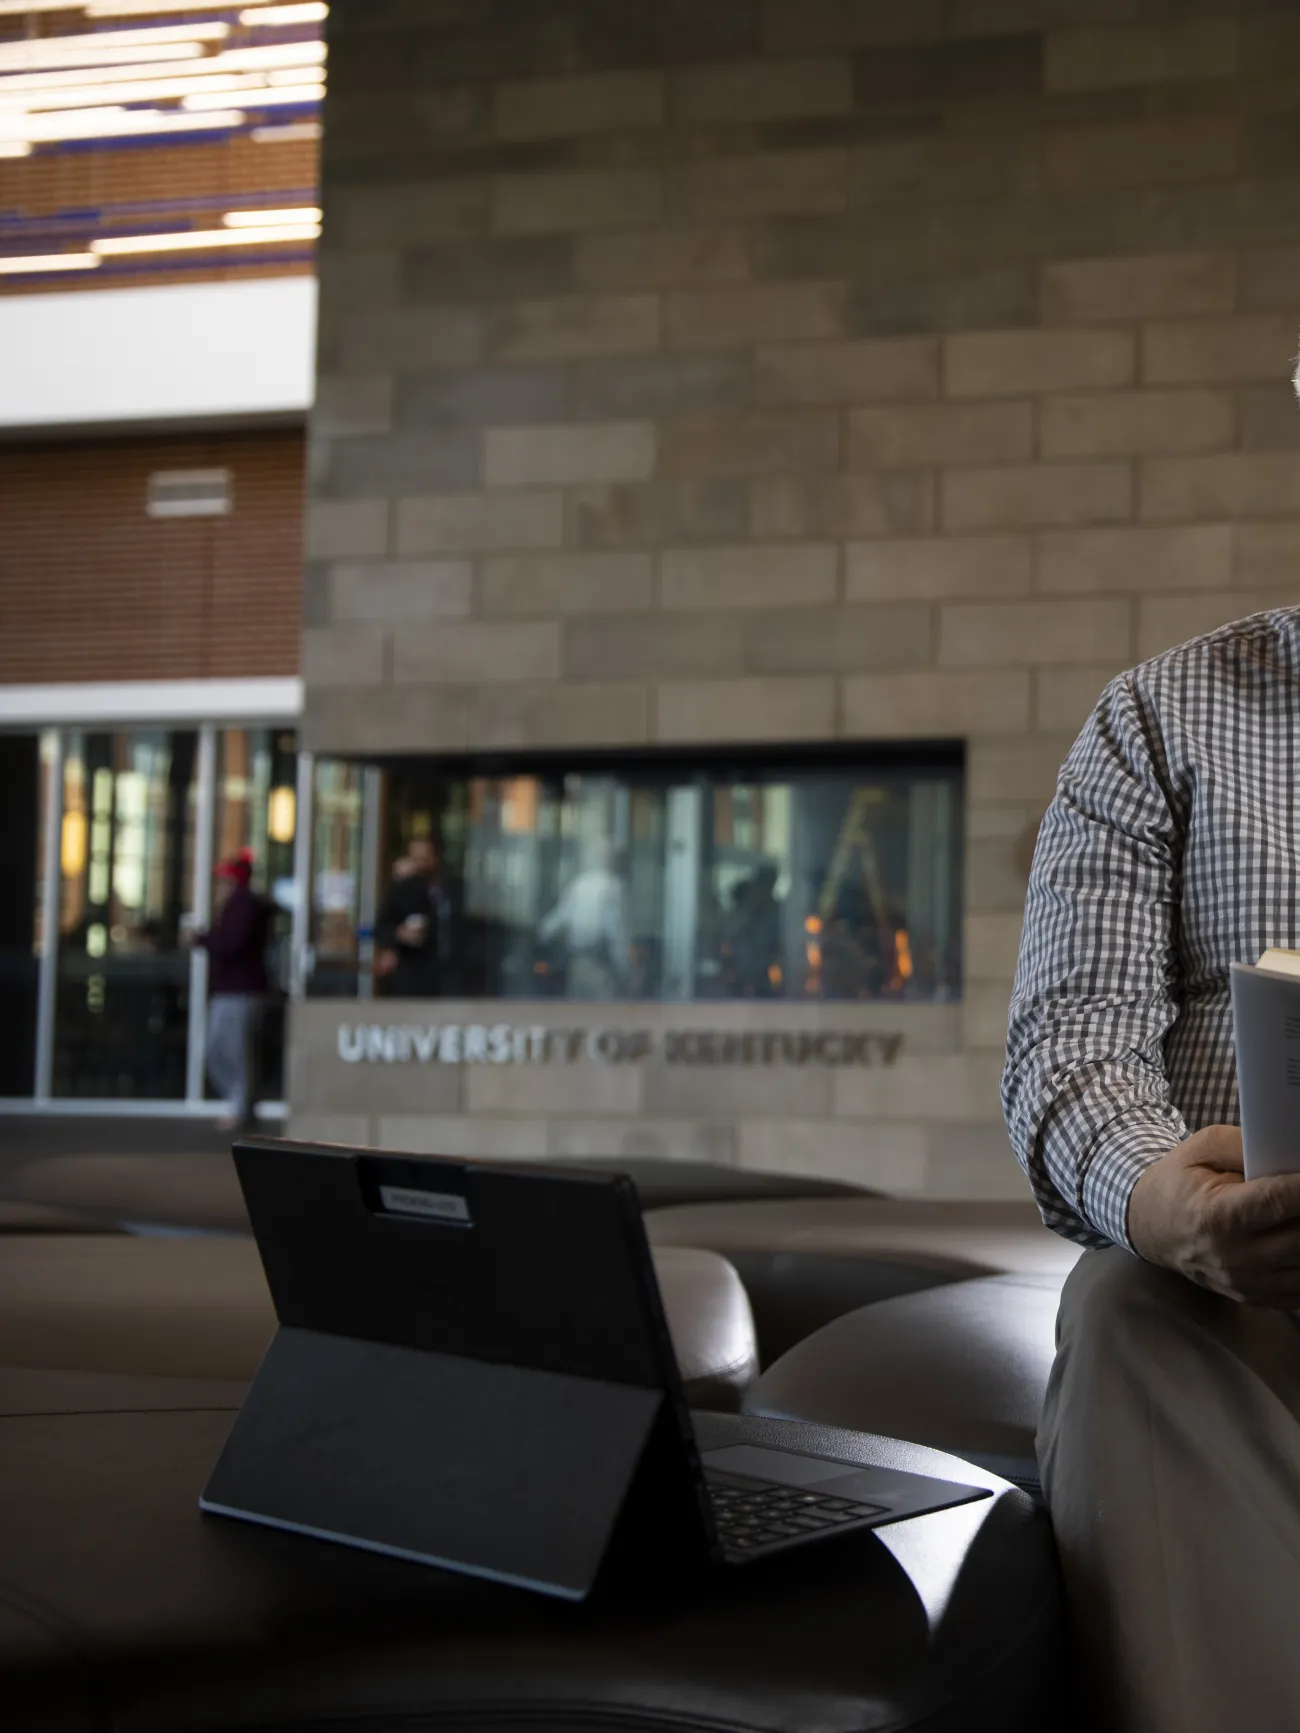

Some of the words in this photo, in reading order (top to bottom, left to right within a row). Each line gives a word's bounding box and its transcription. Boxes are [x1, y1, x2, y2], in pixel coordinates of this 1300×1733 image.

[337, 1024, 585, 1063] UNIVERSITY
[587, 1027, 651, 1064] OF
[664, 1029, 904, 1066] KENTUCKY
